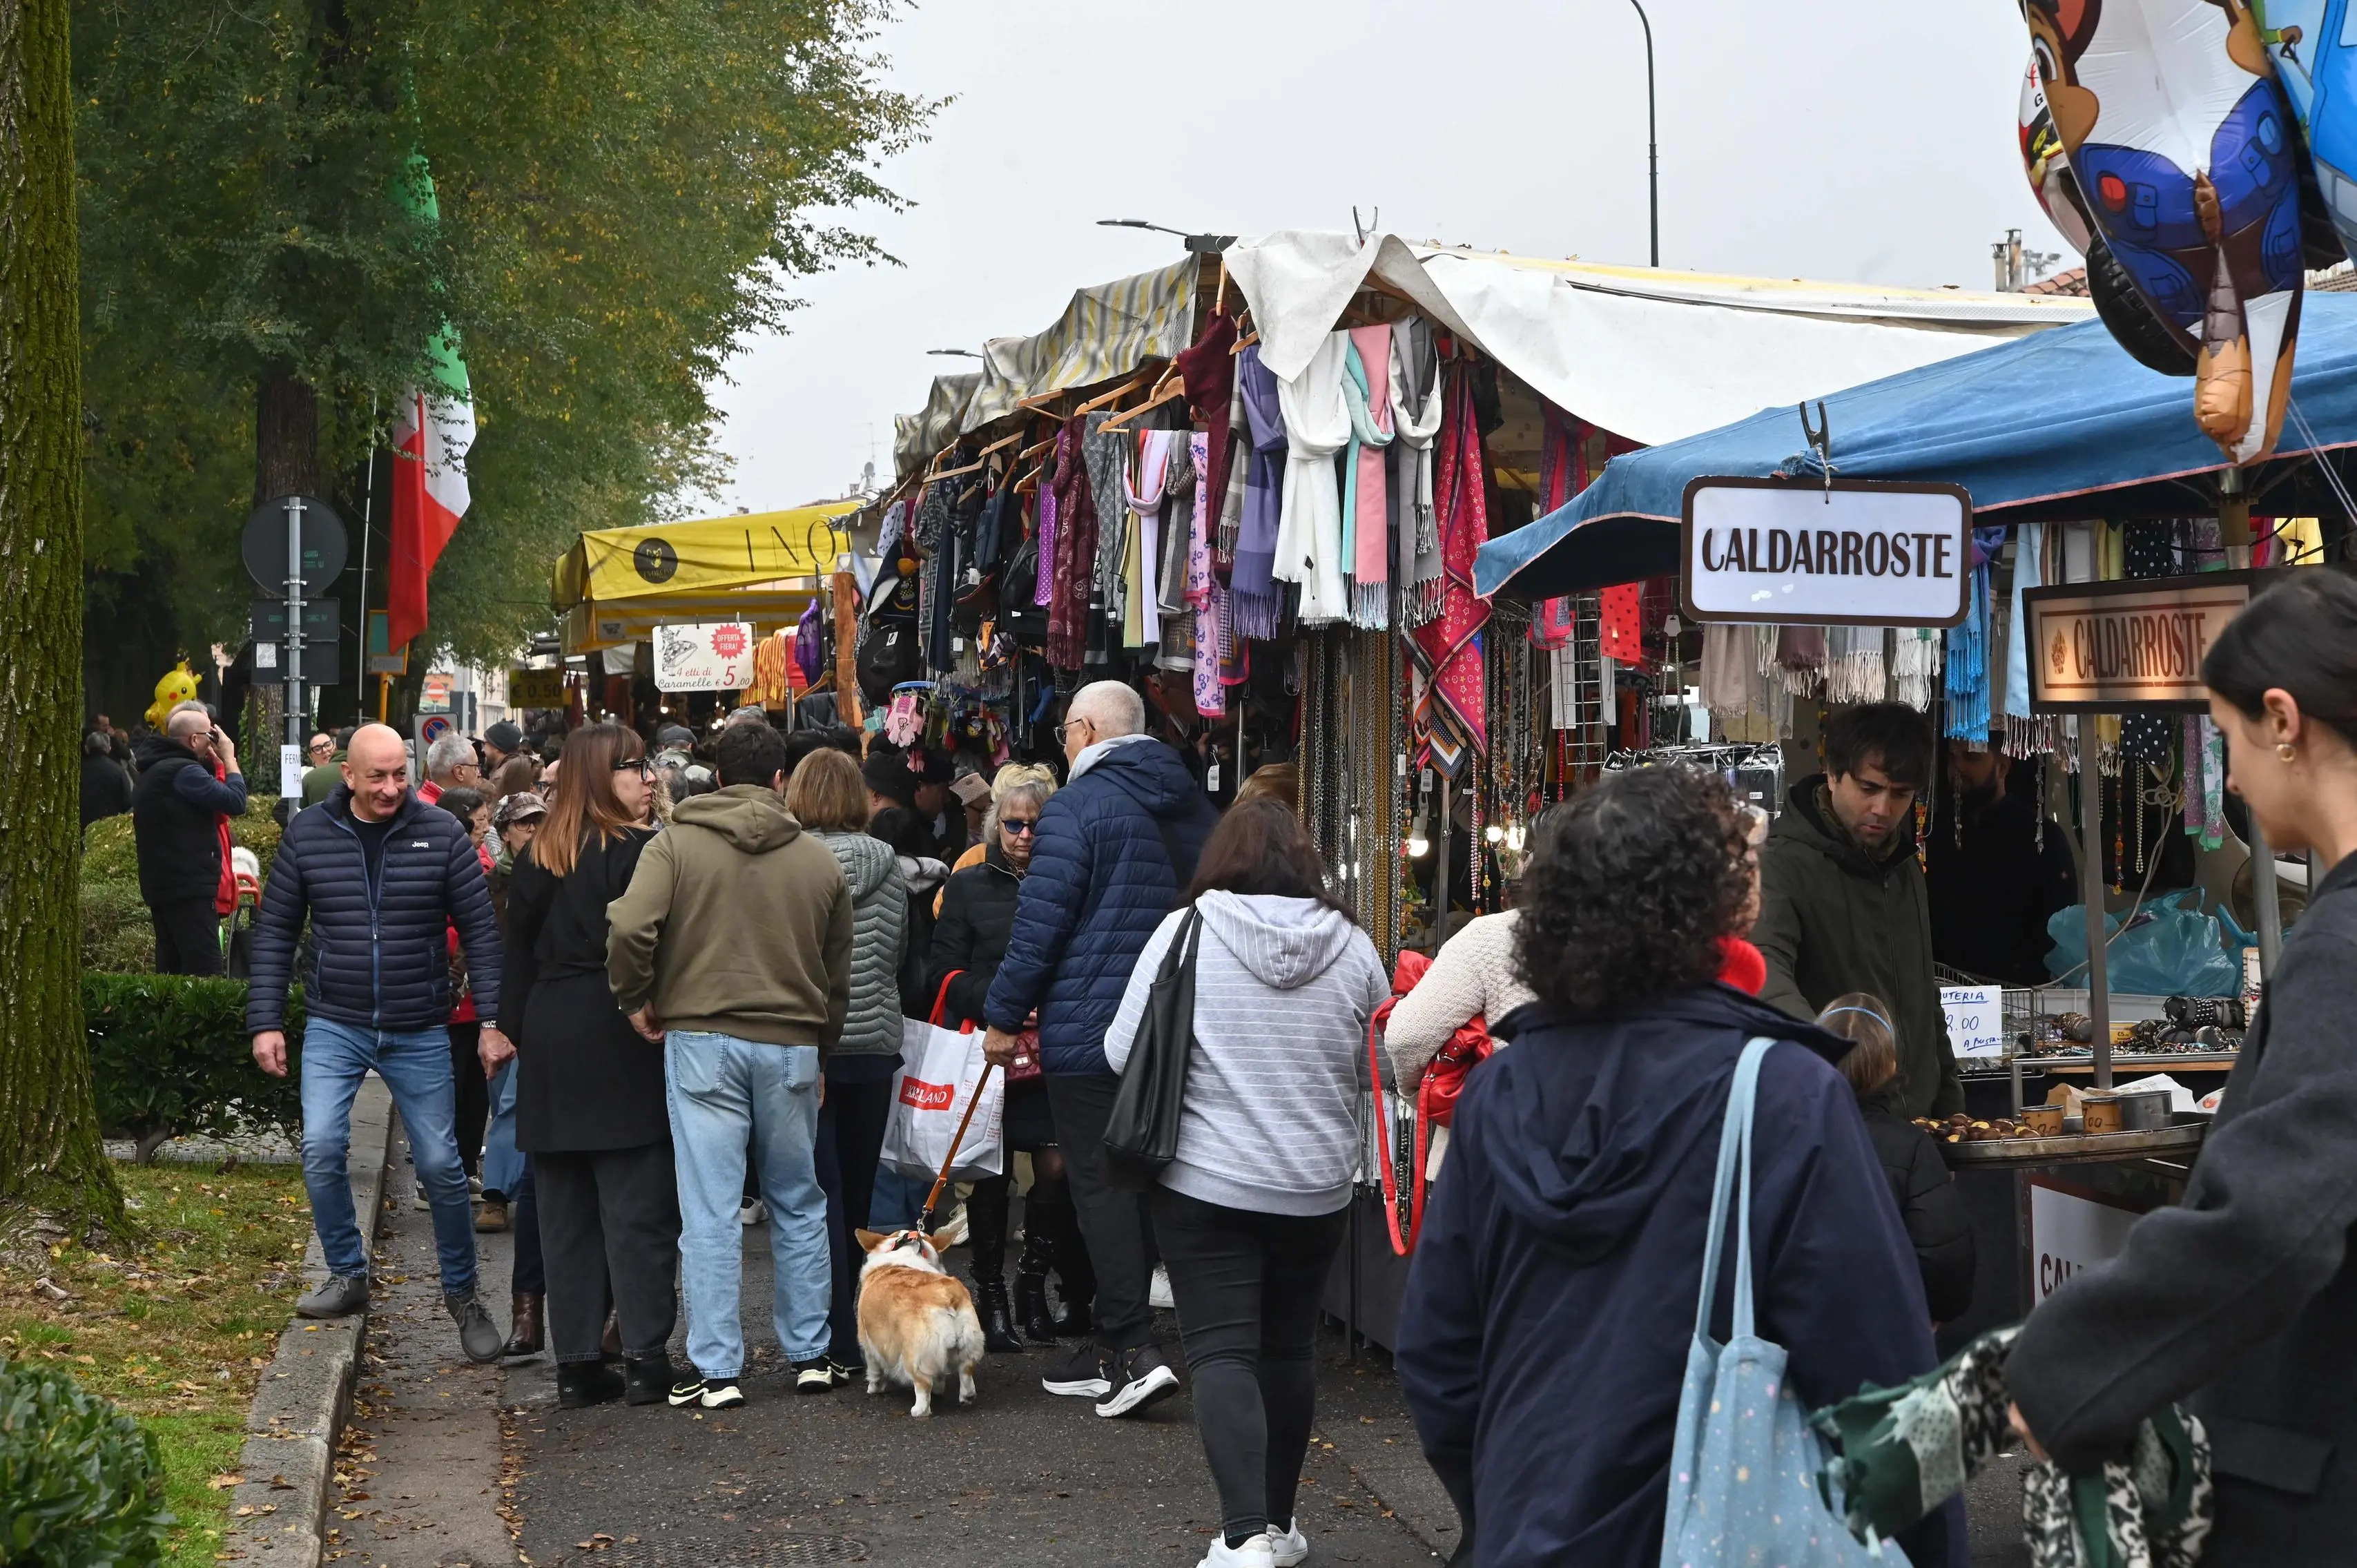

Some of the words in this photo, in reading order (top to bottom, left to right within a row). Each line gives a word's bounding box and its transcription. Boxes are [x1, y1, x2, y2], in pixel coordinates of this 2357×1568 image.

[770, 520, 851, 572] NO
[1702, 527, 1953, 579] CALDARROSTE
[717, 634, 741, 642] OFFERTA
[719, 642, 738, 650] FIERA!
[2073, 612, 2207, 679] CALDARROSTE
[685, 668, 700, 677] etti
[702, 666, 712, 677] di
[658, 678, 712, 689] Caramelle
[1941, 991, 1985, 1001] UTERIA
